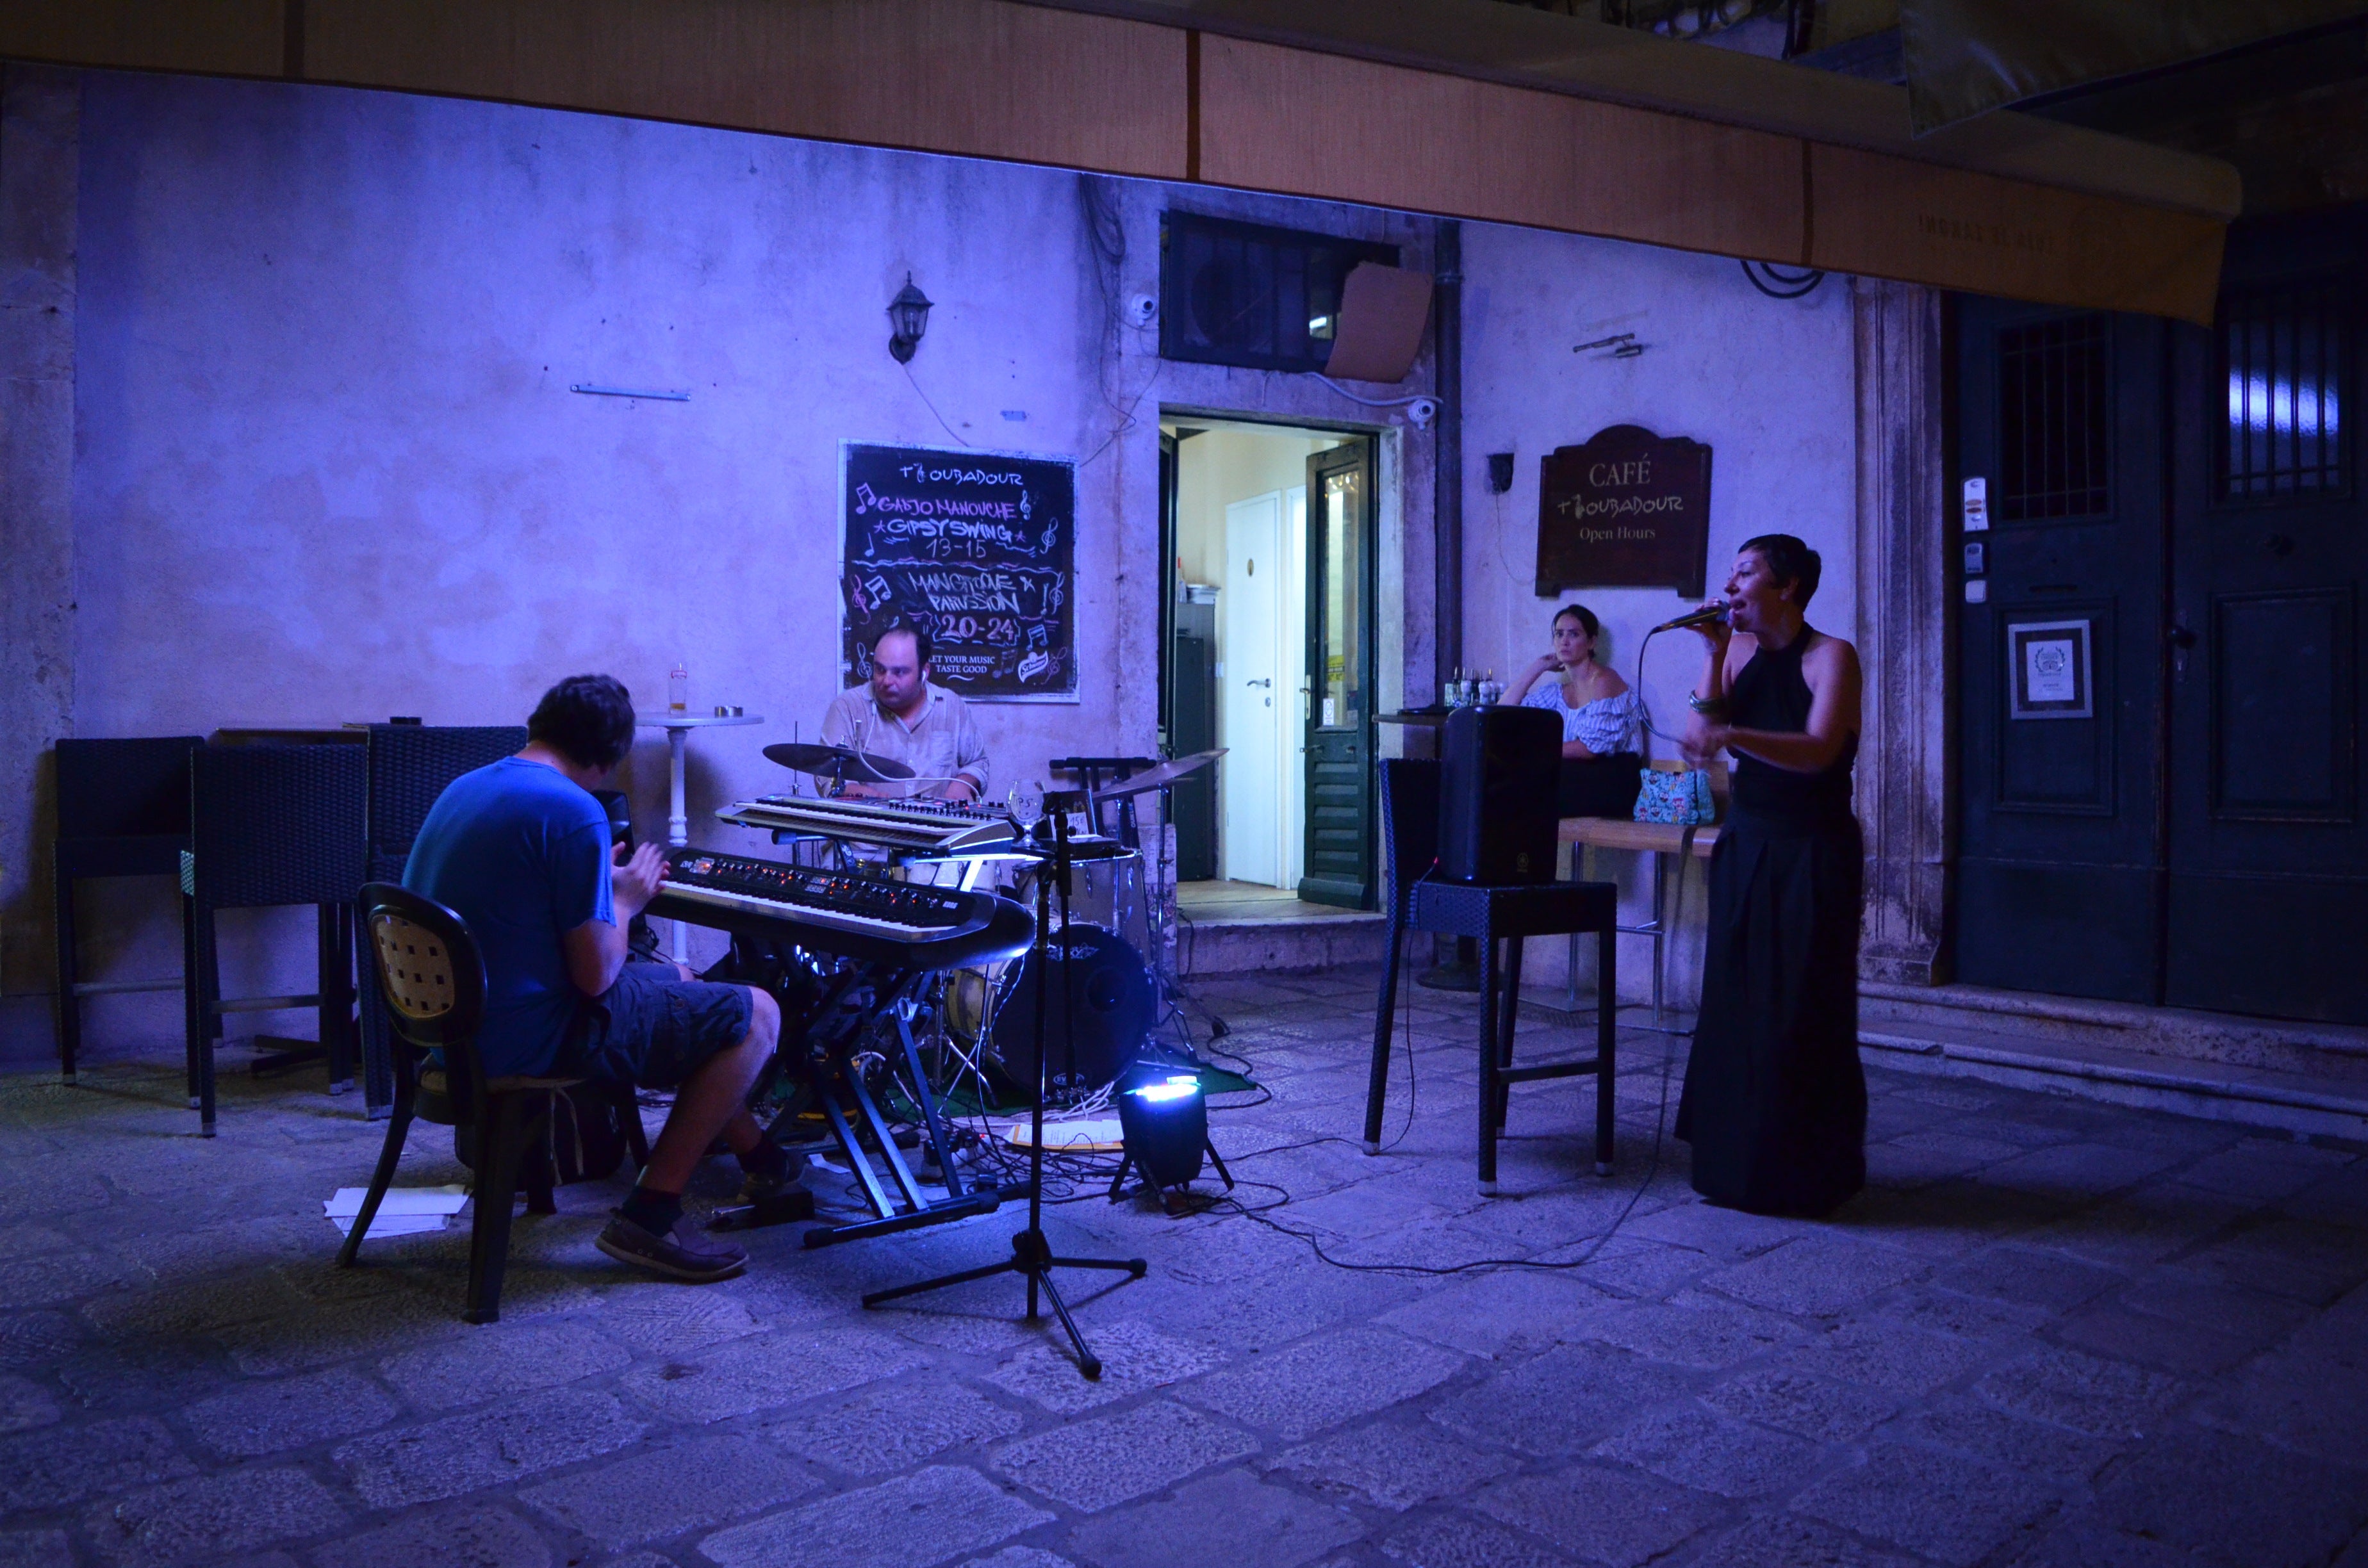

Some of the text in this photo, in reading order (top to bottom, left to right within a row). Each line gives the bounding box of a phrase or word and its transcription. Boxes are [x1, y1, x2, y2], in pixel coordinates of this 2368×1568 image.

[1589, 453, 1651, 487] CAFÉ
[935, 498, 1017, 521] MANOUCHE
[887, 518, 949, 537] GIPSY
[1579, 526, 1656, 543] Open Hours
[941, 614, 1014, 641] 20-24
[936, 664, 987, 674] TASTE GOOD
[944, 655, 967, 664] YOUR
[969, 655, 996, 665] MUSIC
